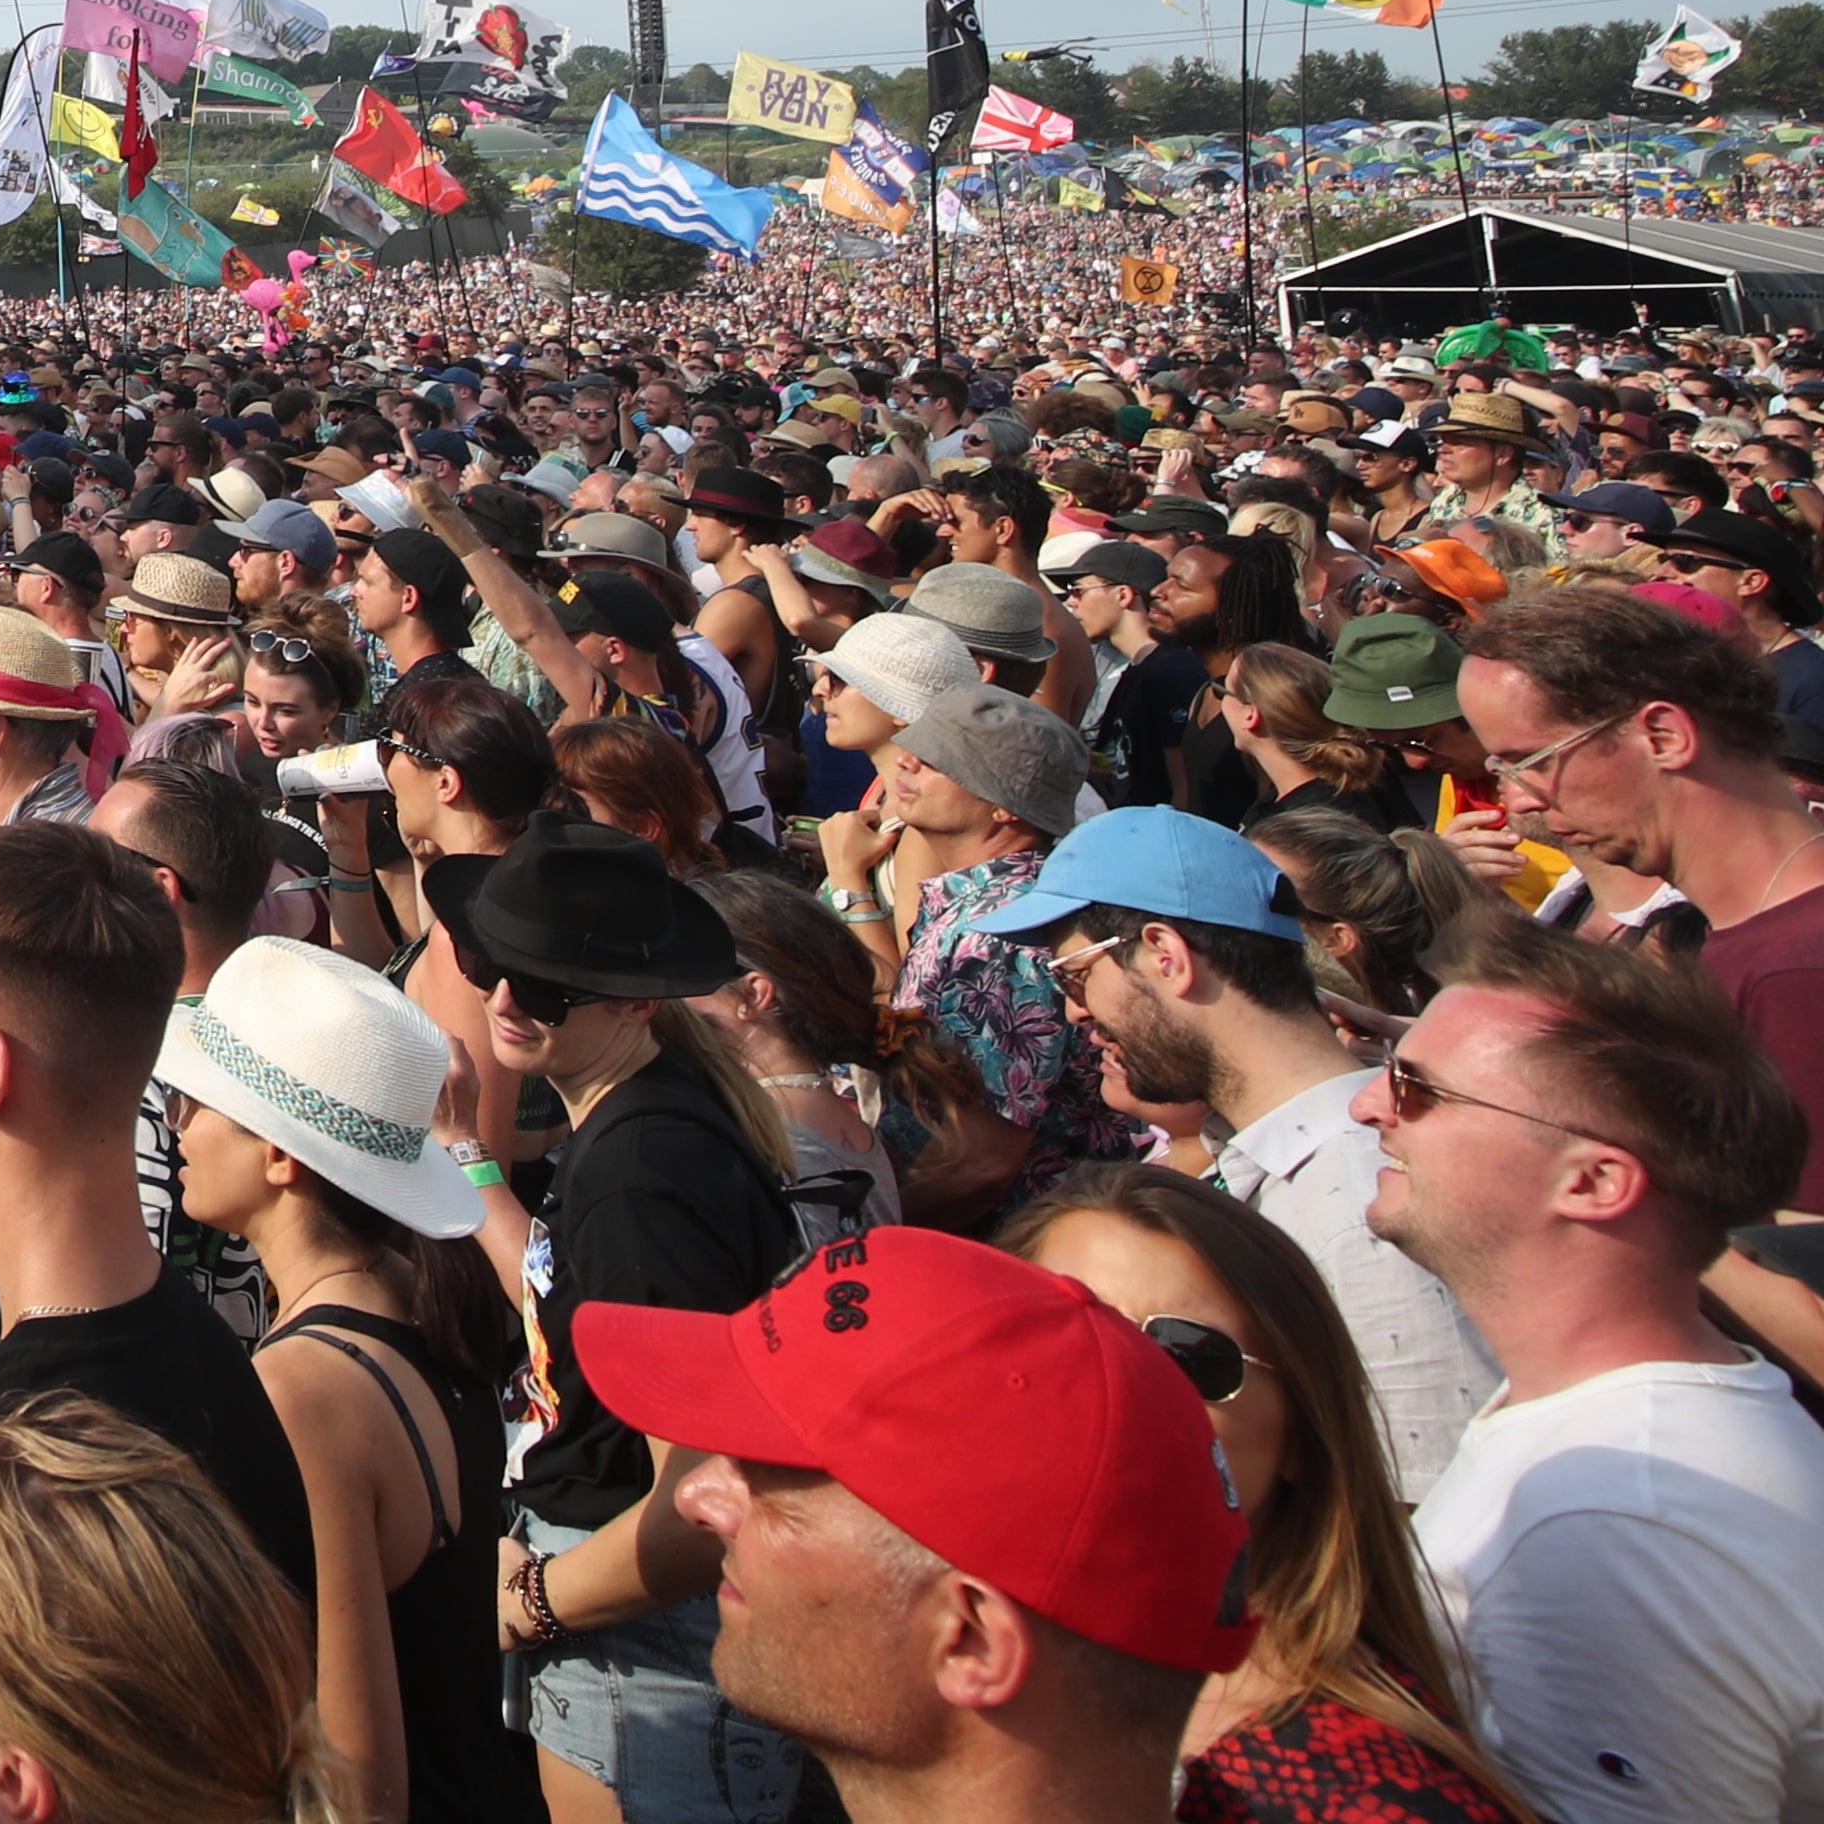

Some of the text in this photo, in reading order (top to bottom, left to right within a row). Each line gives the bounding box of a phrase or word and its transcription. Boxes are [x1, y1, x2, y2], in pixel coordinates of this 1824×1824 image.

[213, 61, 308, 116] Shannon
[762, 68, 832, 104] RAY
[760, 92, 830, 130] VON
[824, 1281, 870, 1333] 66
